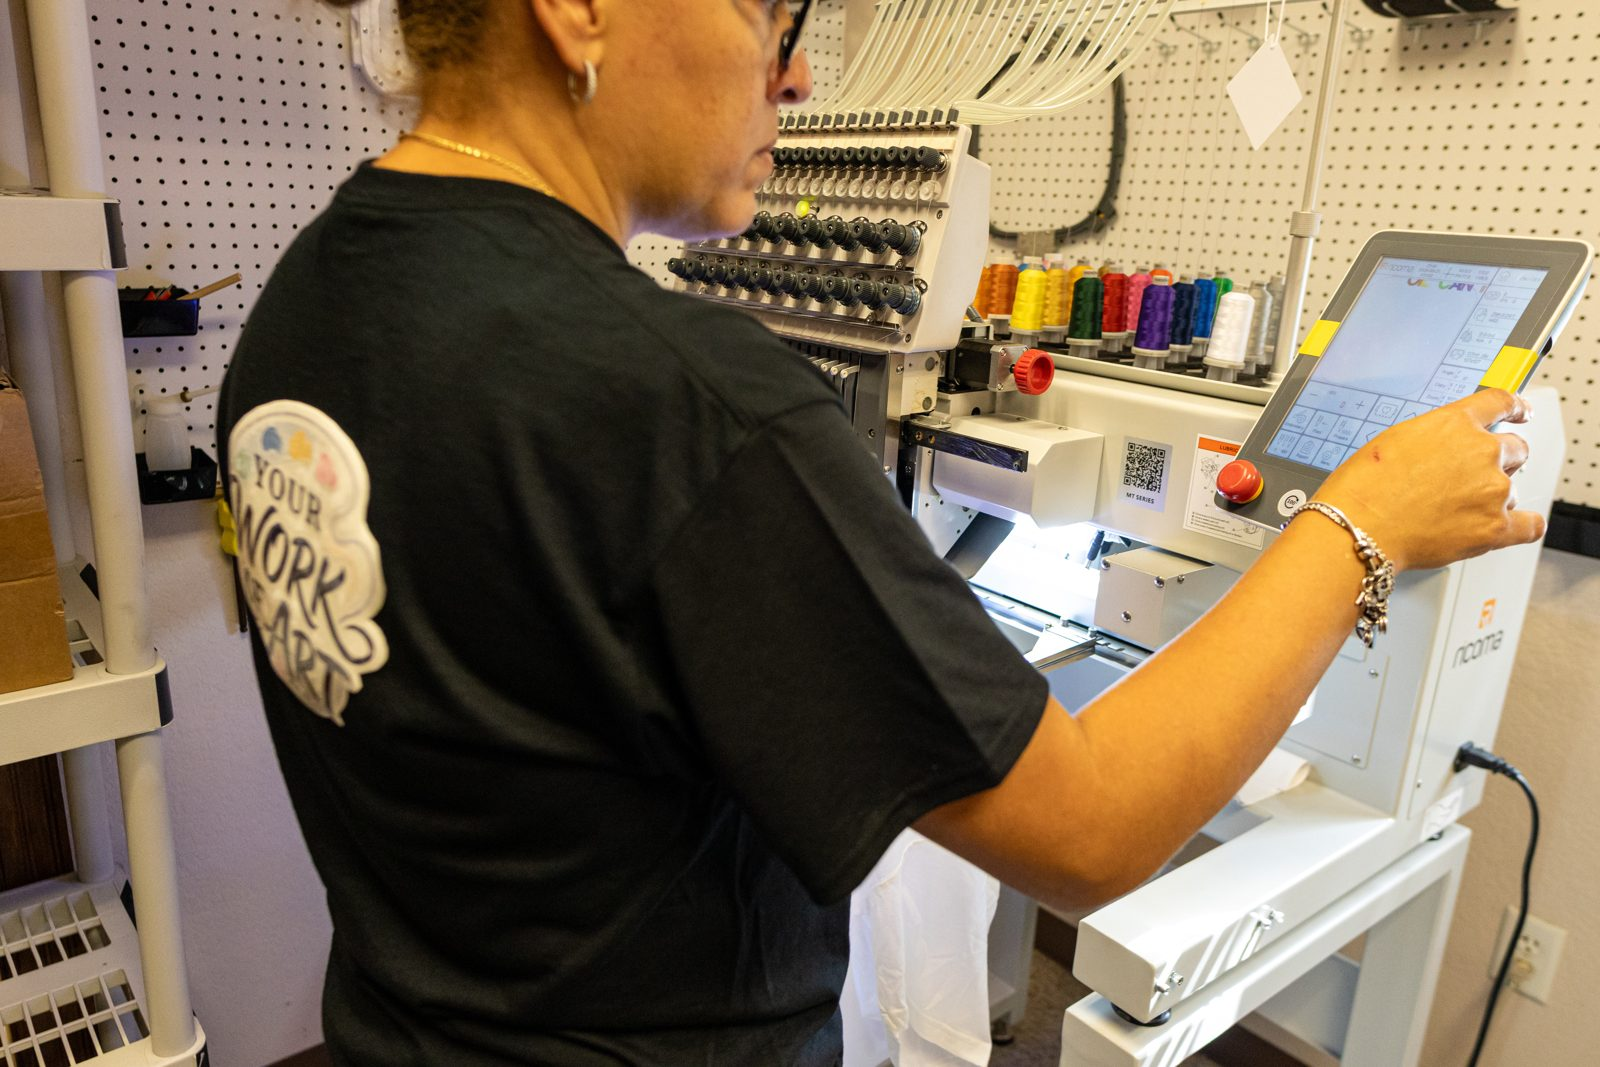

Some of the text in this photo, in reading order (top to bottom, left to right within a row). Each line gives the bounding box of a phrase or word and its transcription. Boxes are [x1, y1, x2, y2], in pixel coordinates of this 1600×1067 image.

[254, 453, 322, 531] YOUR
[1136, 494, 1155, 504] SERIES
[229, 474, 374, 665] WORK
[263, 601, 352, 713] ART
